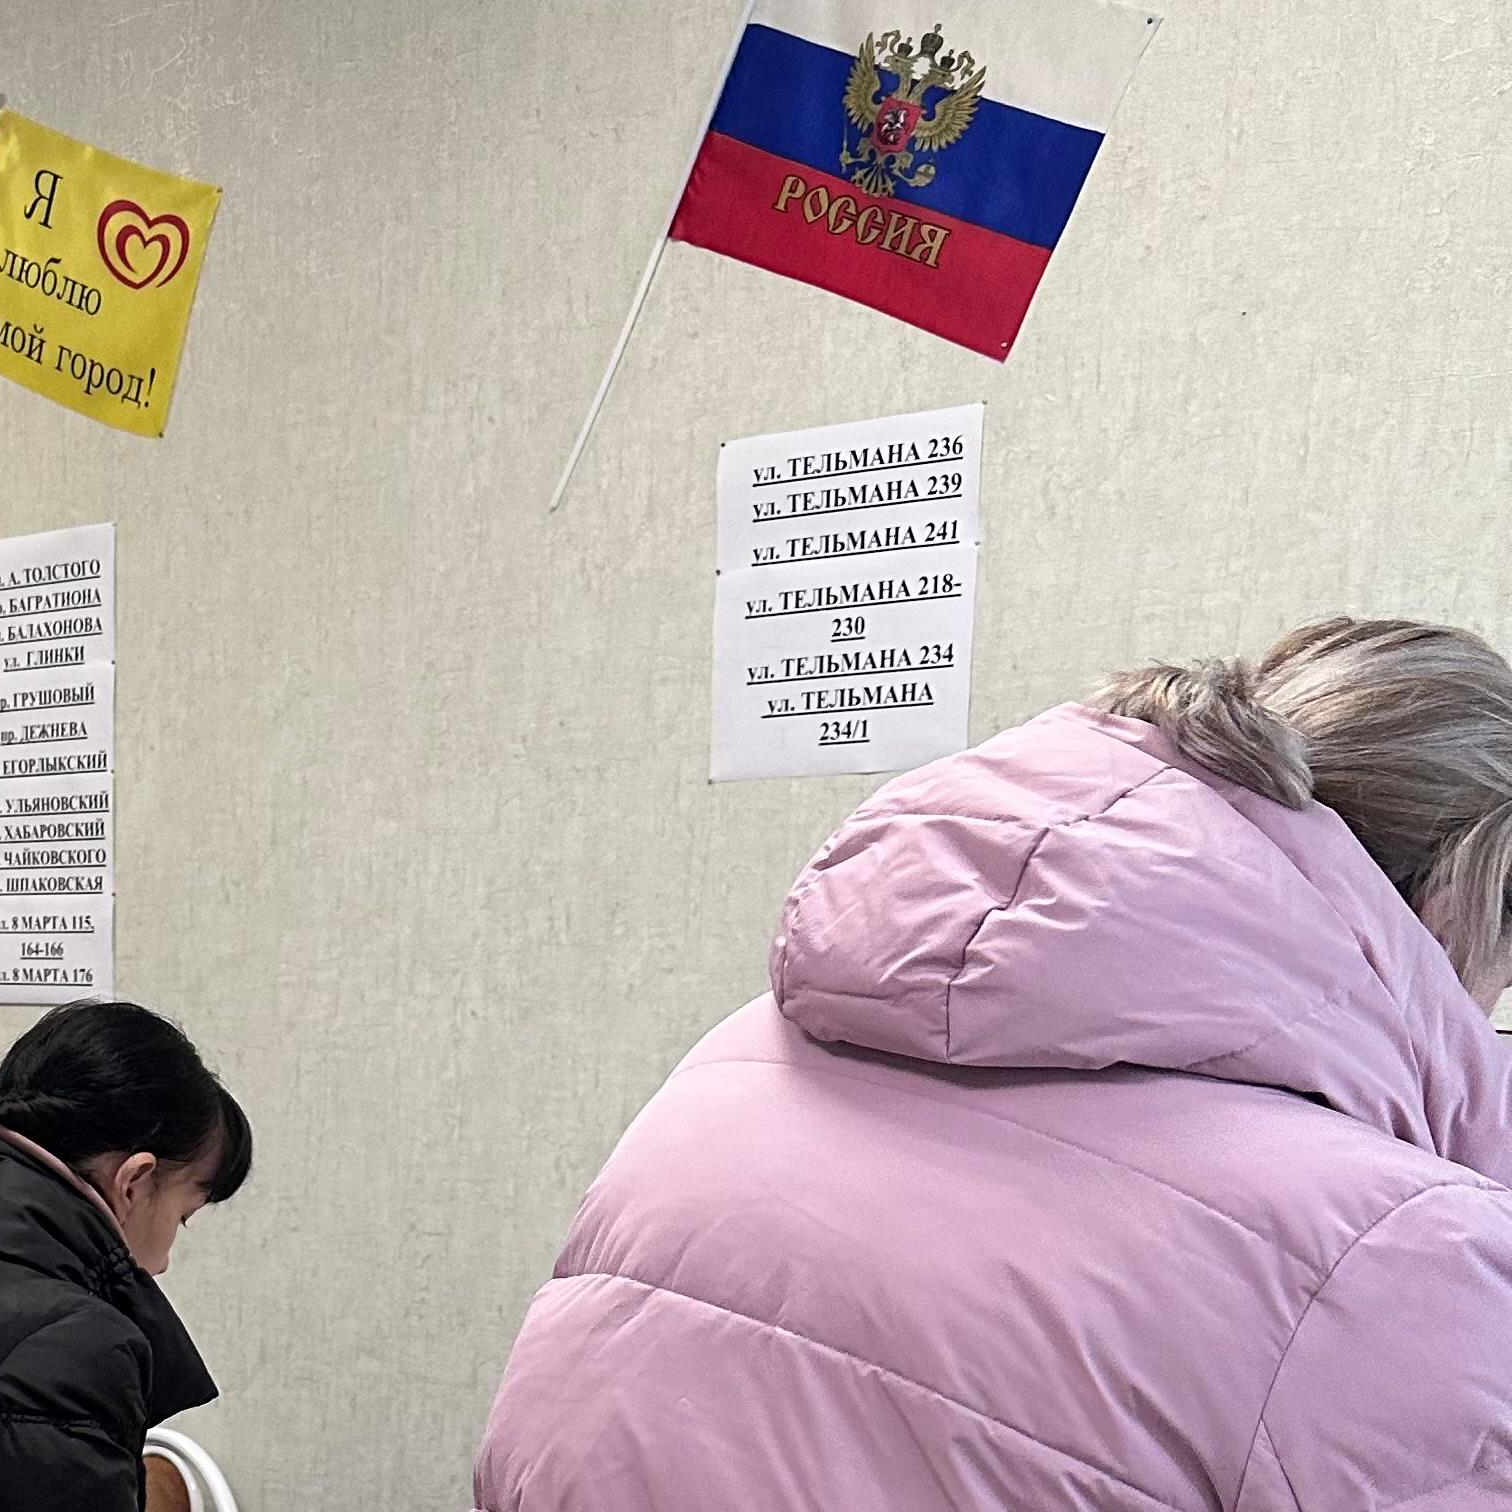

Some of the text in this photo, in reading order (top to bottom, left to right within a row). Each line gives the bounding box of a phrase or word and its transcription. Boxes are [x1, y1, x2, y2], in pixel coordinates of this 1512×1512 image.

[24, 169, 63, 229] Я
[774, 175, 951, 268] РОССИЯ
[55, 344, 156, 408] город!
[753, 435, 963, 484] ул. ТЕЛЬМАНА 236
[753, 473, 962, 519] ул. ТЕЛЬМАНА 239
[753, 520, 959, 564] ул. ТЕЛЬМАНА 241
[23, 559, 101, 584] ТОЛСТОГО
[9, 588, 101, 613] БАГРАТИОНА
[746, 573, 962, 617] ул. ТЕЛЬМАНА 218-
[8, 617, 103, 642] БАЛАХОНОВА
[831, 616, 865, 638] 230
[26, 646, 84, 666] ГЛИНКИ
[748, 643, 954, 682] ул. ТЕЛЬМАНА 234
[13, 682, 95, 708] ГРУШОВЫЙ
[767, 682, 934, 715] ул. ТЕЛЬМАНА
[20, 722, 88, 743] ДЕЖНЕВА
[819, 720, 869, 741] 234/1
[3, 750, 107, 775] ЕГОРЛЫКСКИЙ
[6, 790, 109, 814] УЛЬЯНОВСКИЙ
[4, 818, 105, 840] ХАБАРОВСКИЙ
[4, 848, 106, 866] ЧАЙКОВСКОГО
[6, 876, 103, 892] ШПАКОВСКАЯ
[11, 916, 19, 930] 8
[21, 916, 68, 930] МАРТА
[21, 942, 64, 956] 164-166
[12, 968, 20, 982] 8
[22, 968, 68, 982] МАРТА
[72, 968, 93, 982] 176
